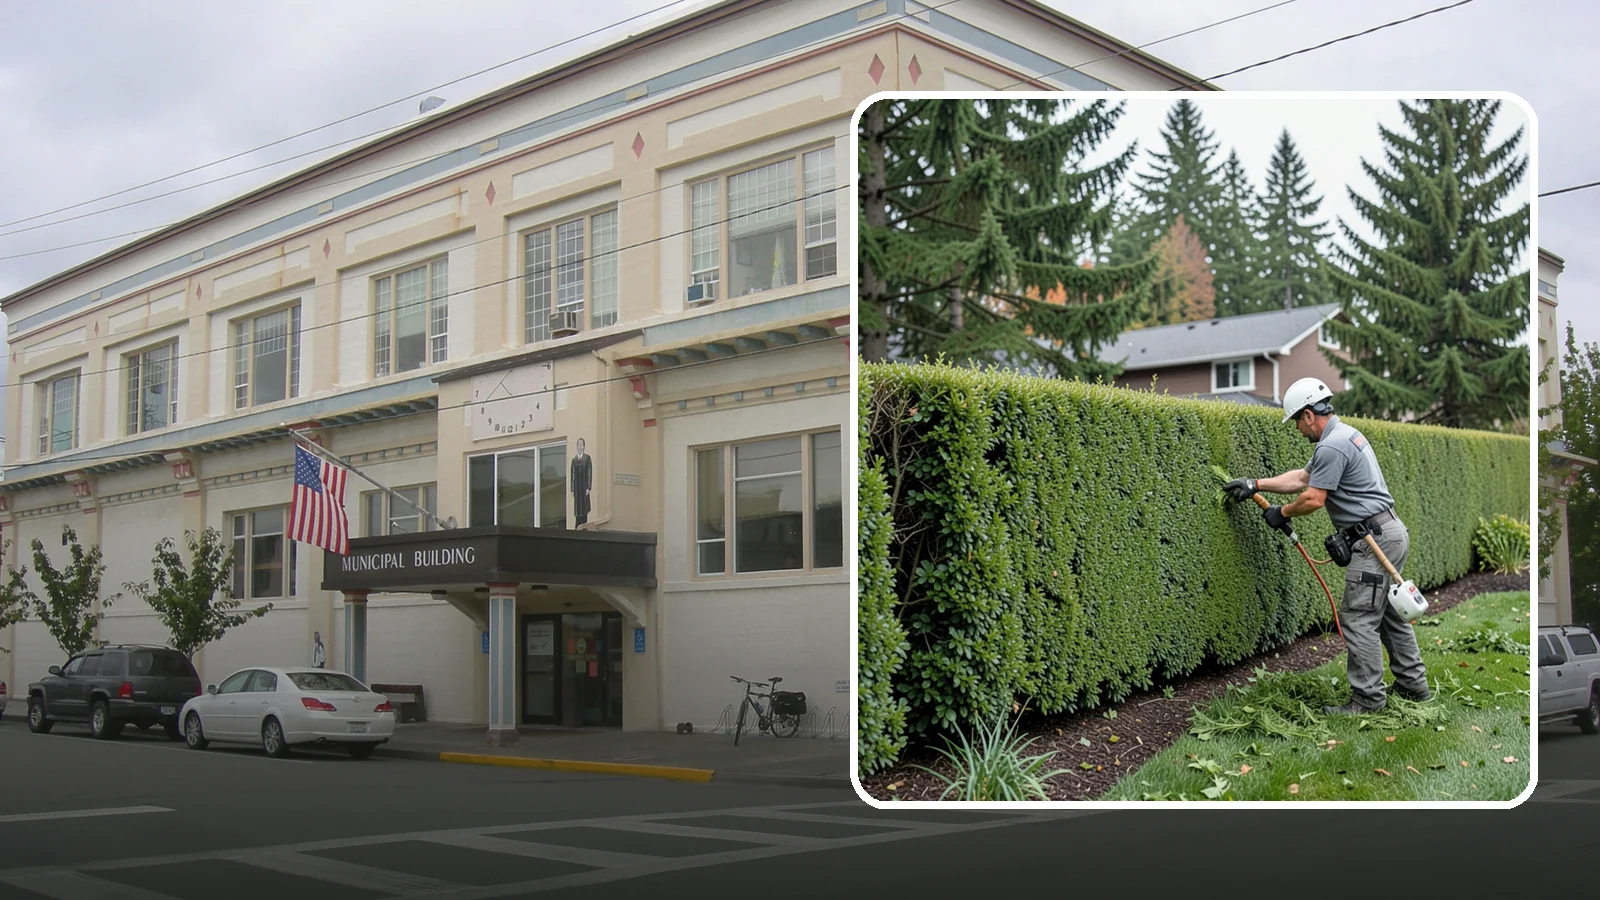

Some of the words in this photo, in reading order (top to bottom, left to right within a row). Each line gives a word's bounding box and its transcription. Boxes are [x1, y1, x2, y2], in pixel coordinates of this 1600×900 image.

[529, 414, 532, 422] 3
[342, 552, 405, 572] MUNICIPAL
[414, 546, 475, 566] BUILDING
